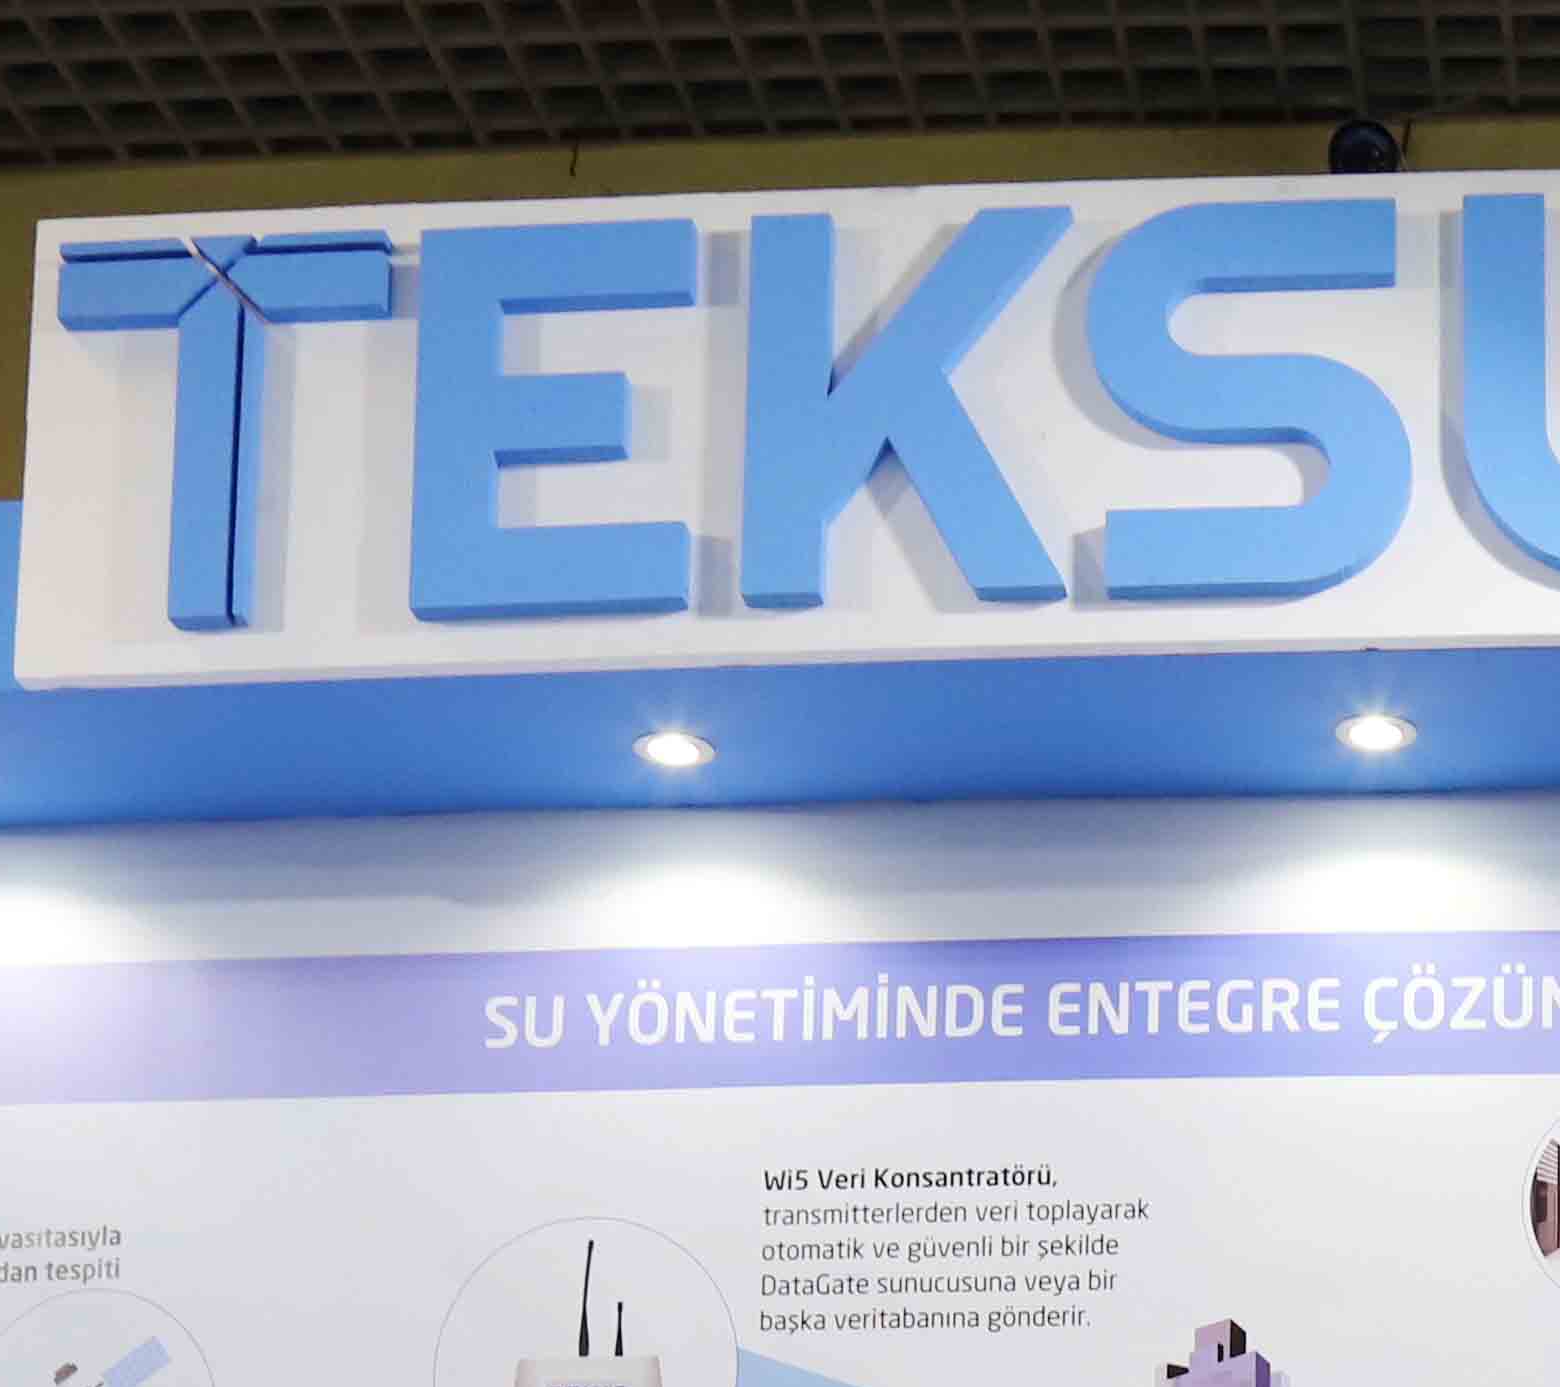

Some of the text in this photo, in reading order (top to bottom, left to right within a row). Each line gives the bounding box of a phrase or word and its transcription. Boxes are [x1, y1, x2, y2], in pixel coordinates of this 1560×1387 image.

[484, 996, 566, 1049] SU
[586, 972, 1026, 1046] YÖNETİMİNDE
[1047, 976, 1341, 1036] ENTEGRE
[764, 1163, 1057, 1192] Wi5 Veri Konsantratörü,
[763, 1197, 1150, 1227] transmitterlerden veri toplayarak
[761, 1233, 1119, 1265] otomatik ve güvenli bir şekilde
[44, 1256, 121, 1285] tespiti
[761, 1268, 1118, 1297] DataGate sunucusuna veya bir
[759, 1304, 1091, 1336] başka veritabanına gönderir.
